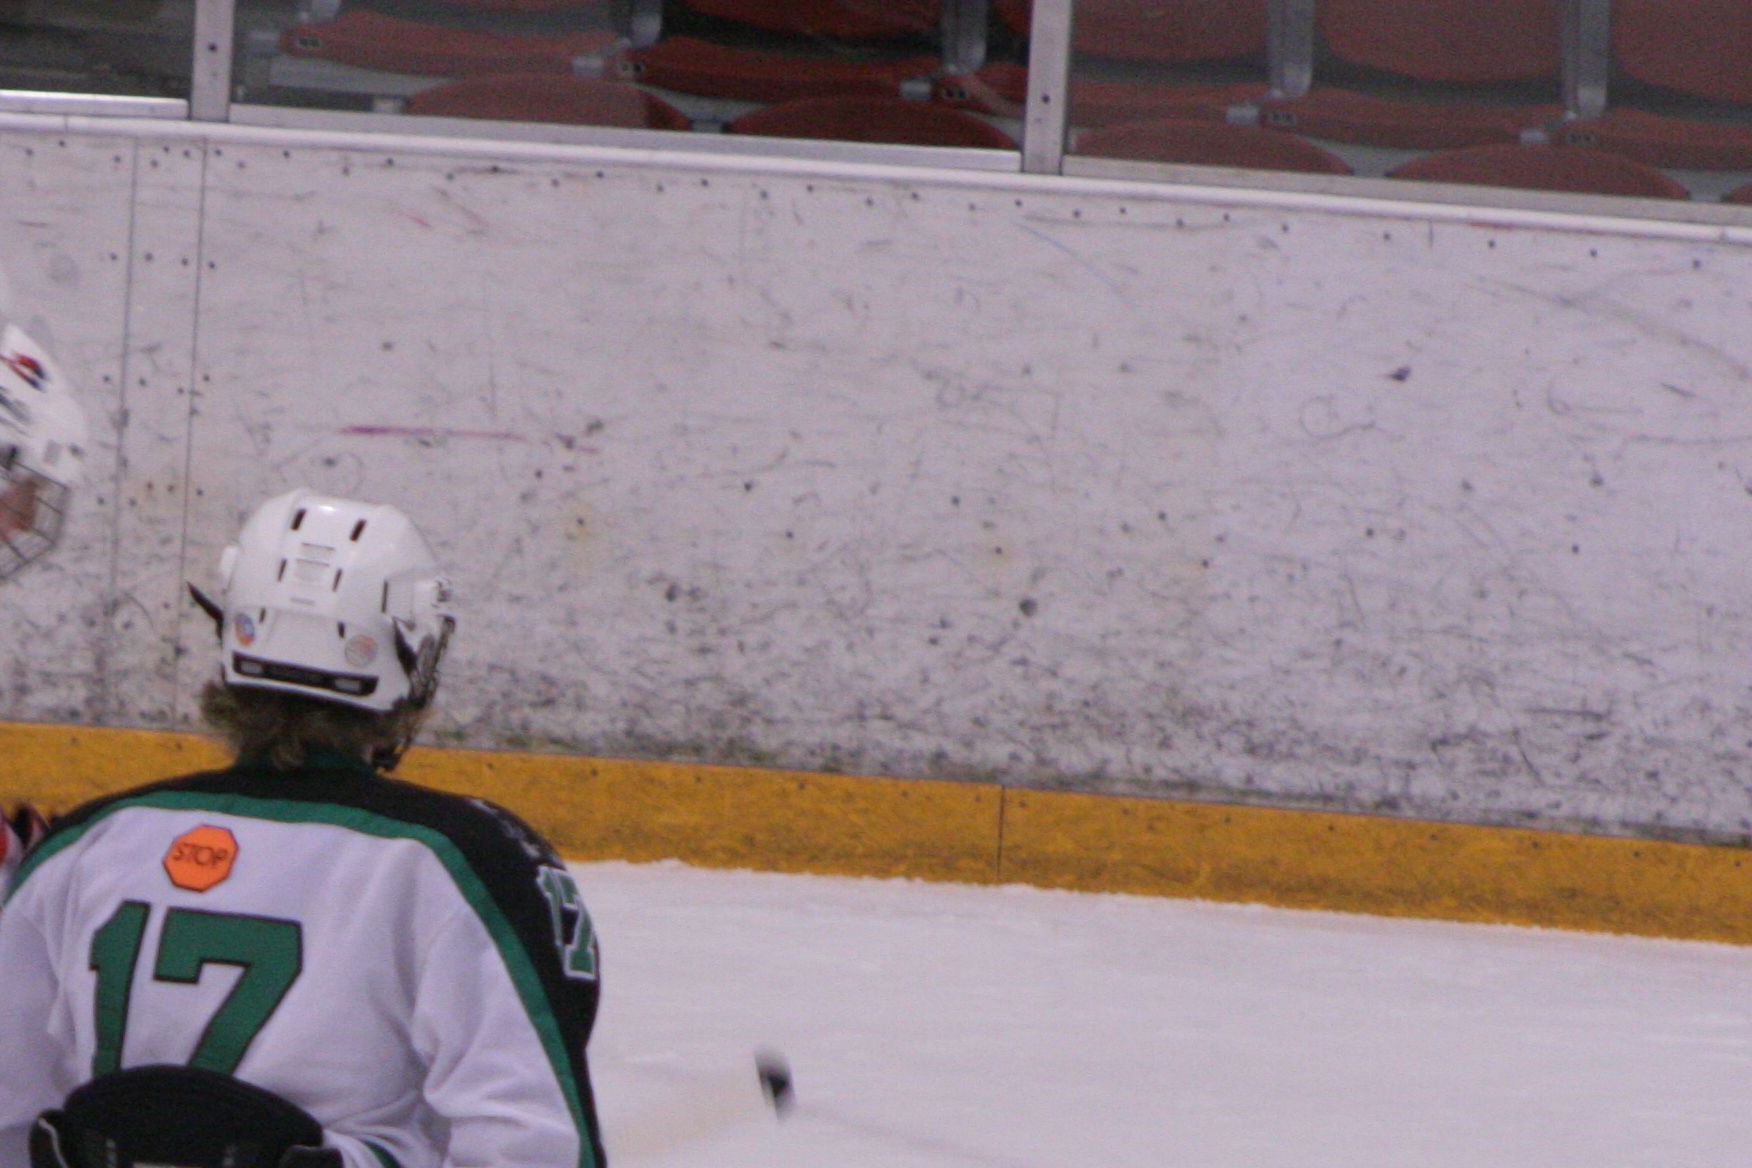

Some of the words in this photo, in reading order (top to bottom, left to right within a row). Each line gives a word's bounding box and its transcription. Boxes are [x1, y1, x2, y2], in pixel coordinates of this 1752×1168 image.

[172, 841, 229, 868] STOP
[535, 863, 598, 981] 17
[90, 899, 303, 1080] 17
